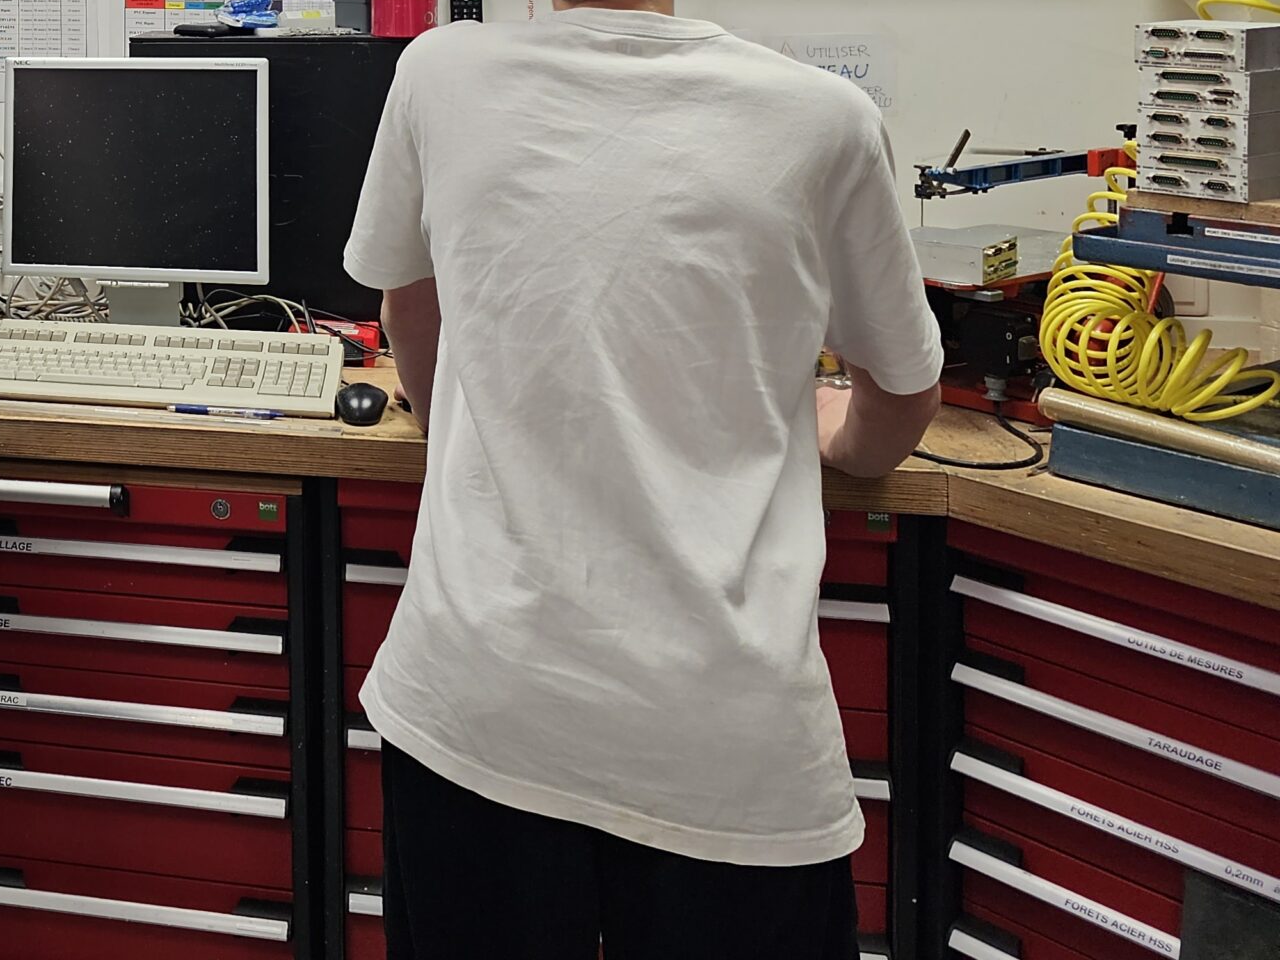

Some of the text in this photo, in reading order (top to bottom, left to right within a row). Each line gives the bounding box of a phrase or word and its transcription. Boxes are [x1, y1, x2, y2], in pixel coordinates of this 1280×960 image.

[806, 44, 871, 59] UTILISER
[817, 64, 869, 79] EAU
[258, 502, 278, 512] bott
[868, 512, 889, 522] bott
[1127, 636, 1244, 680] OUTILS DE MESURES
[1148, 736, 1223, 772] TARAUDAGE
[1070, 804, 1115, 829] FORETS
[1116, 824, 1152, 843] ACIER
[1155, 838, 1180, 854] HSS
[1064, 898, 1173, 954] FORETS ACIER HSS
